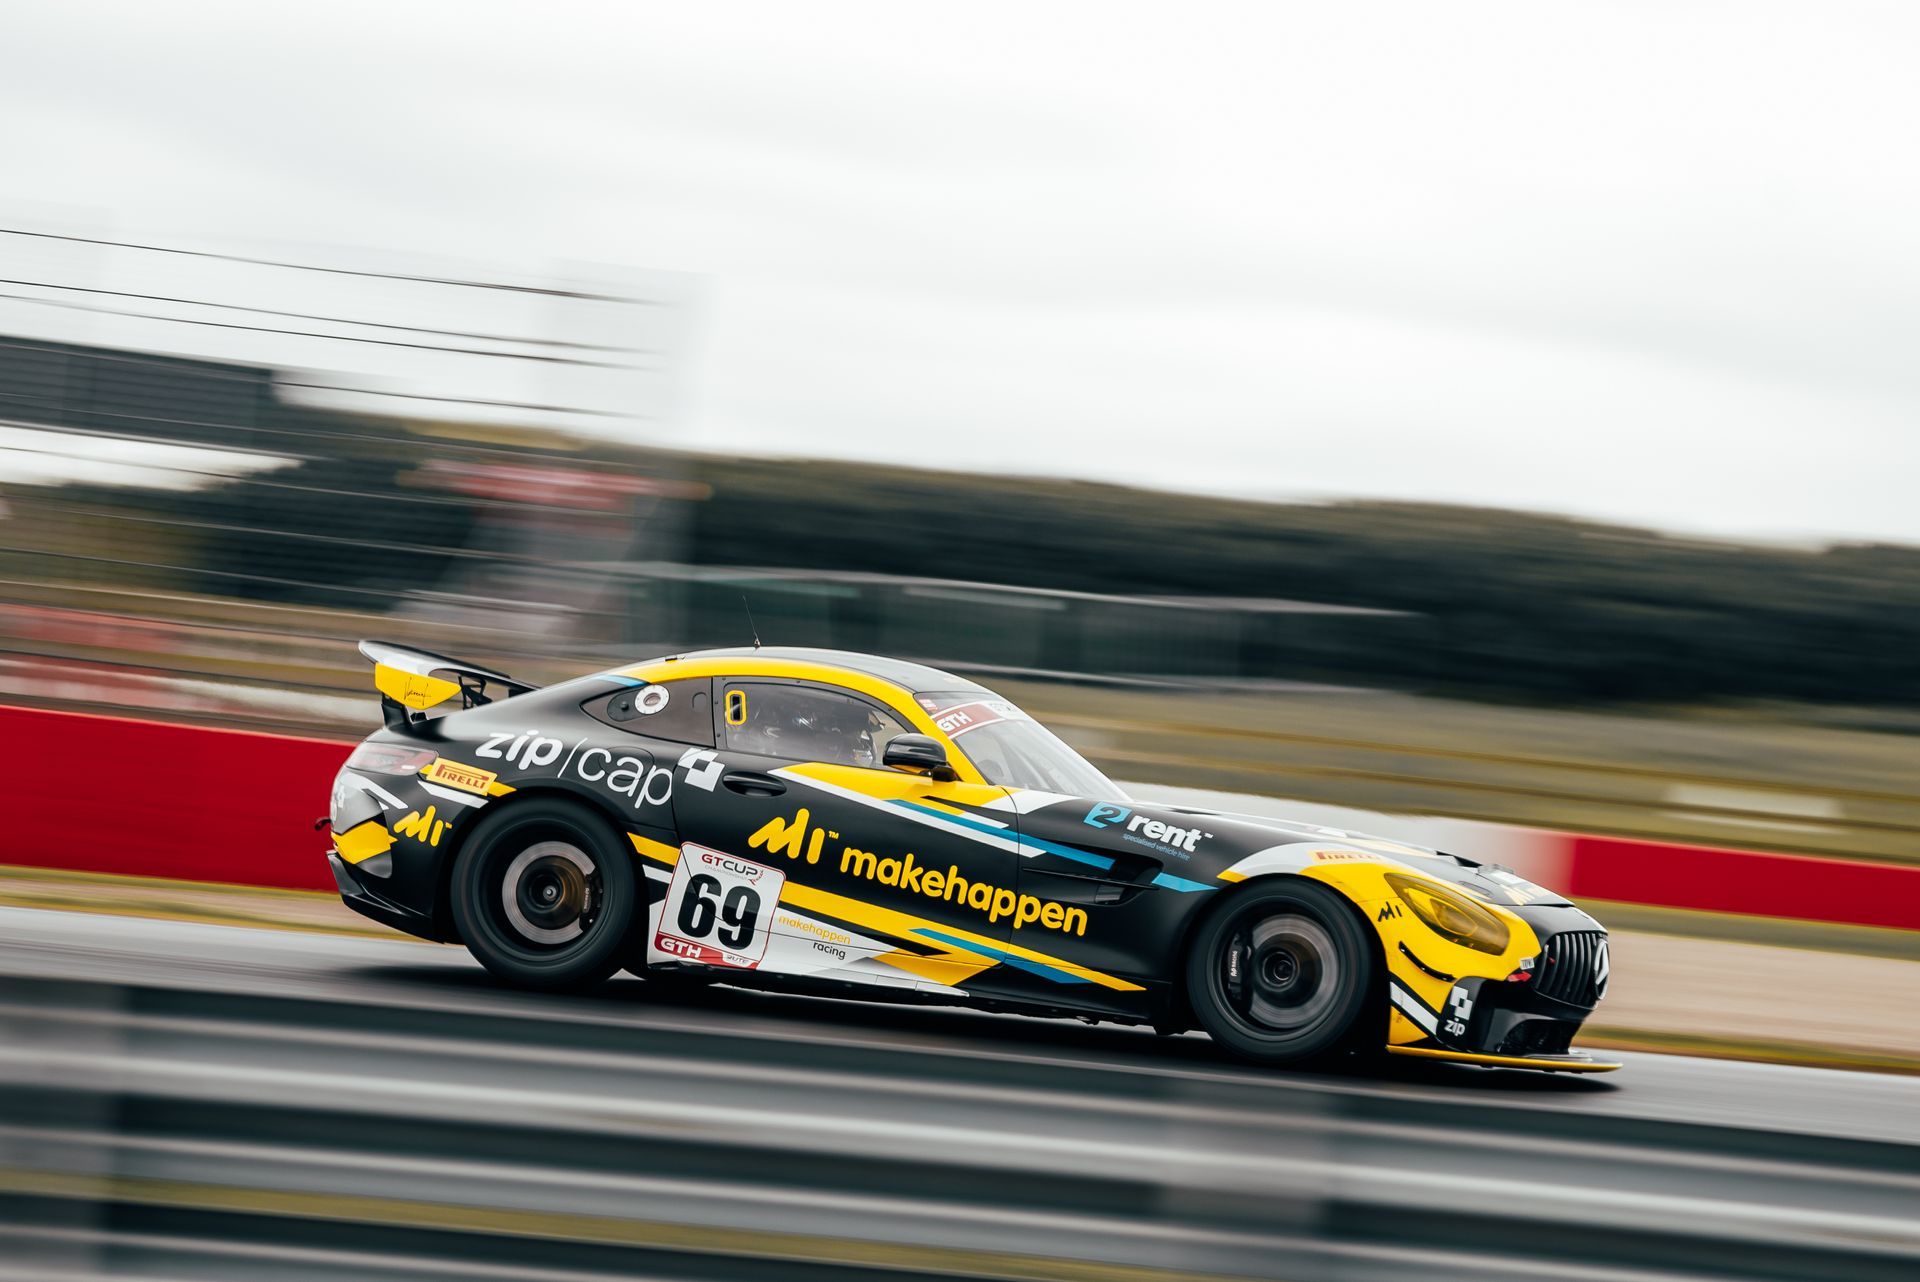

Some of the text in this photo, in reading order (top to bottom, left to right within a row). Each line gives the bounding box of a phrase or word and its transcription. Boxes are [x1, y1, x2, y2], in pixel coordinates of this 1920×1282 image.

[937, 711, 973, 732] GTH
[435, 763, 490, 789] PIRELLI
[840, 845, 1089, 937] makehappen
[677, 872, 761, 951] 69
[778, 915, 851, 945] makehappen
[660, 937, 702, 959] GTH
[813, 942, 846, 960] racing
[1444, 1017, 1466, 1037] zip
